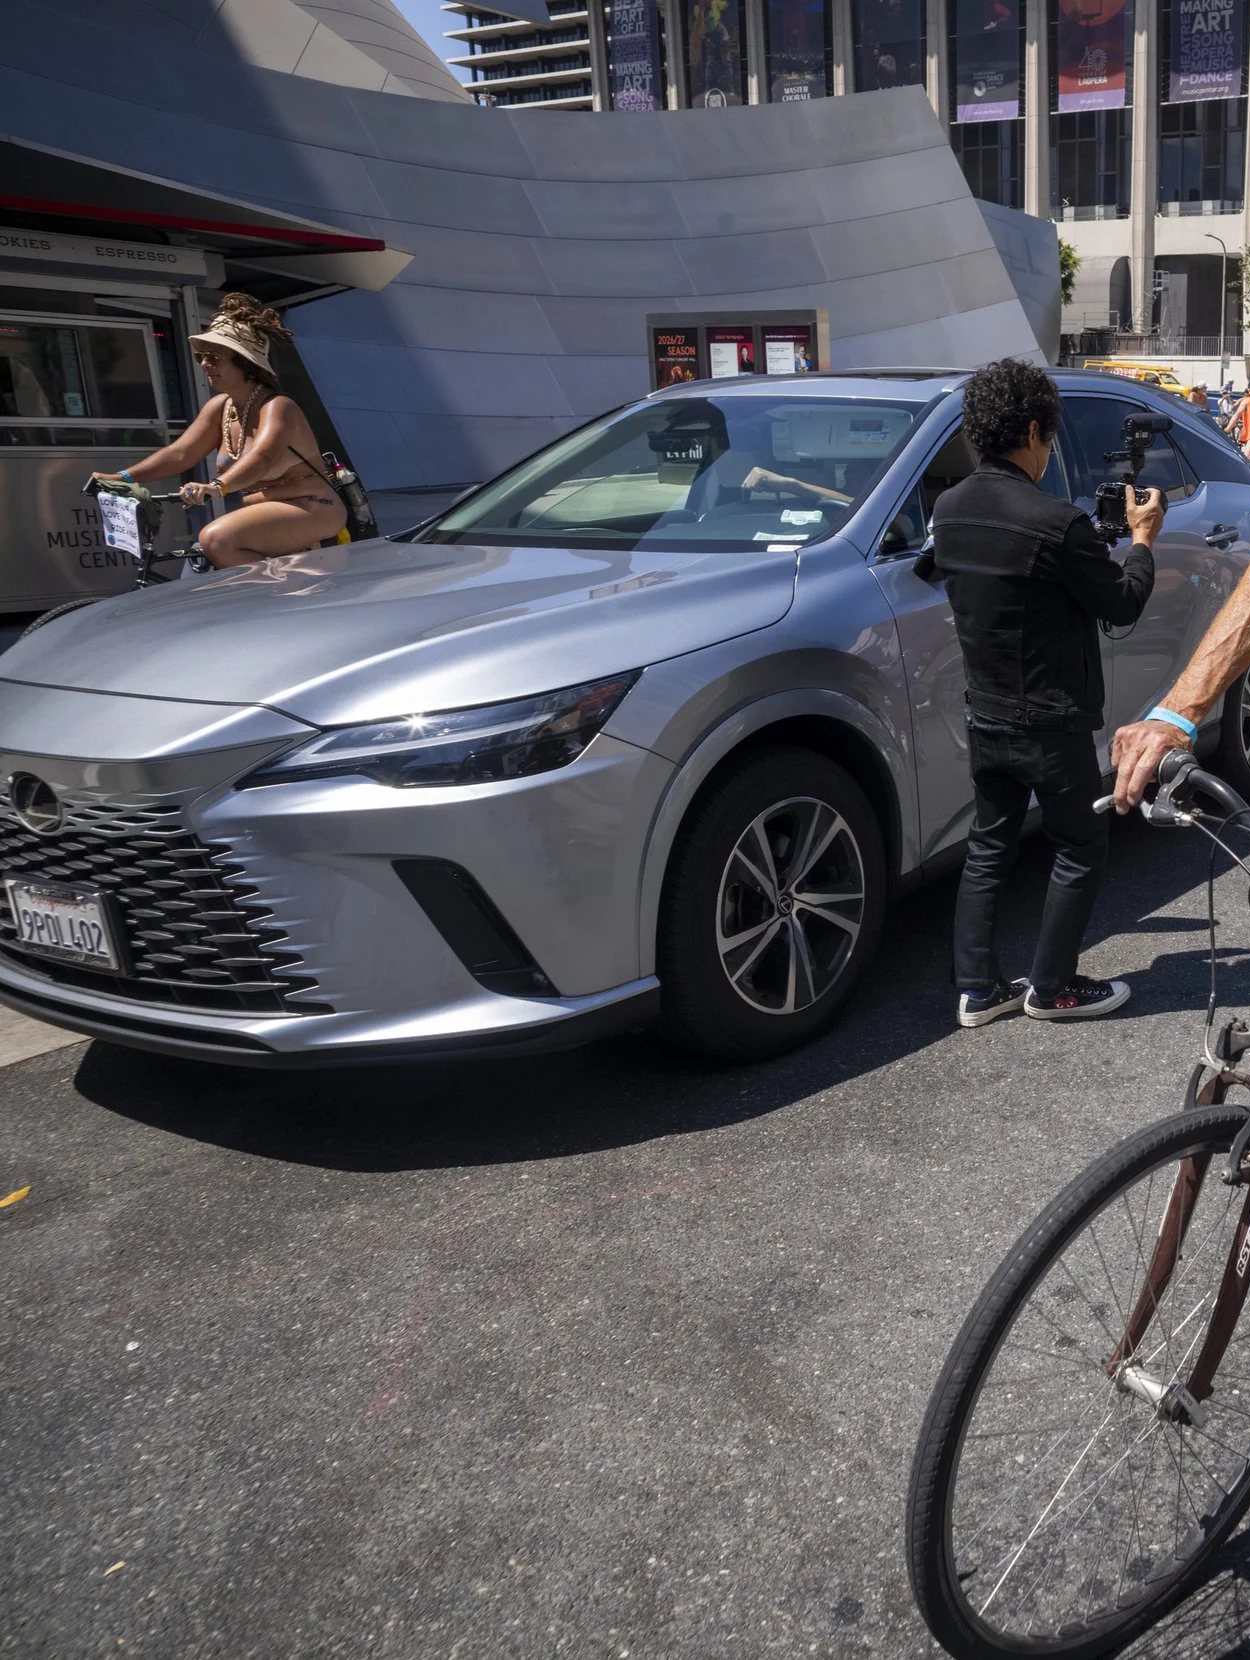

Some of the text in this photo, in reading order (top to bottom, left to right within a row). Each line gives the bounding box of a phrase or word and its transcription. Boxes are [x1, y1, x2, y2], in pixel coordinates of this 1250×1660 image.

[1180, 0, 1234, 14] MAKING
[614, 8, 644, 24] PART
[1191, 9, 1234, 34] ART
[621, 22, 644, 33] OF IT
[1191, 31, 1234, 48] SONG
[1191, 46, 1233, 60] OPERA
[615, 63, 652, 76] MAKING
[1190, 57, 1233, 72] MUSIC
[623, 74, 653, 91] ART
[1190, 71, 1233, 84] DANCE
[624, 91, 653, 103] SONG
[784, 86, 808, 94] MASTER
[1182, 86, 1229, 95] musiccenter.org
[95, 246, 177, 263] ESPRESSO
[657, 335, 685, 345] 2026/27
[667, 346, 696, 356] SEASON
[71, 508, 98, 525] TH
[47, 531, 105, 548] MUSI
[1236, 1239, 1250, 1276] RST
